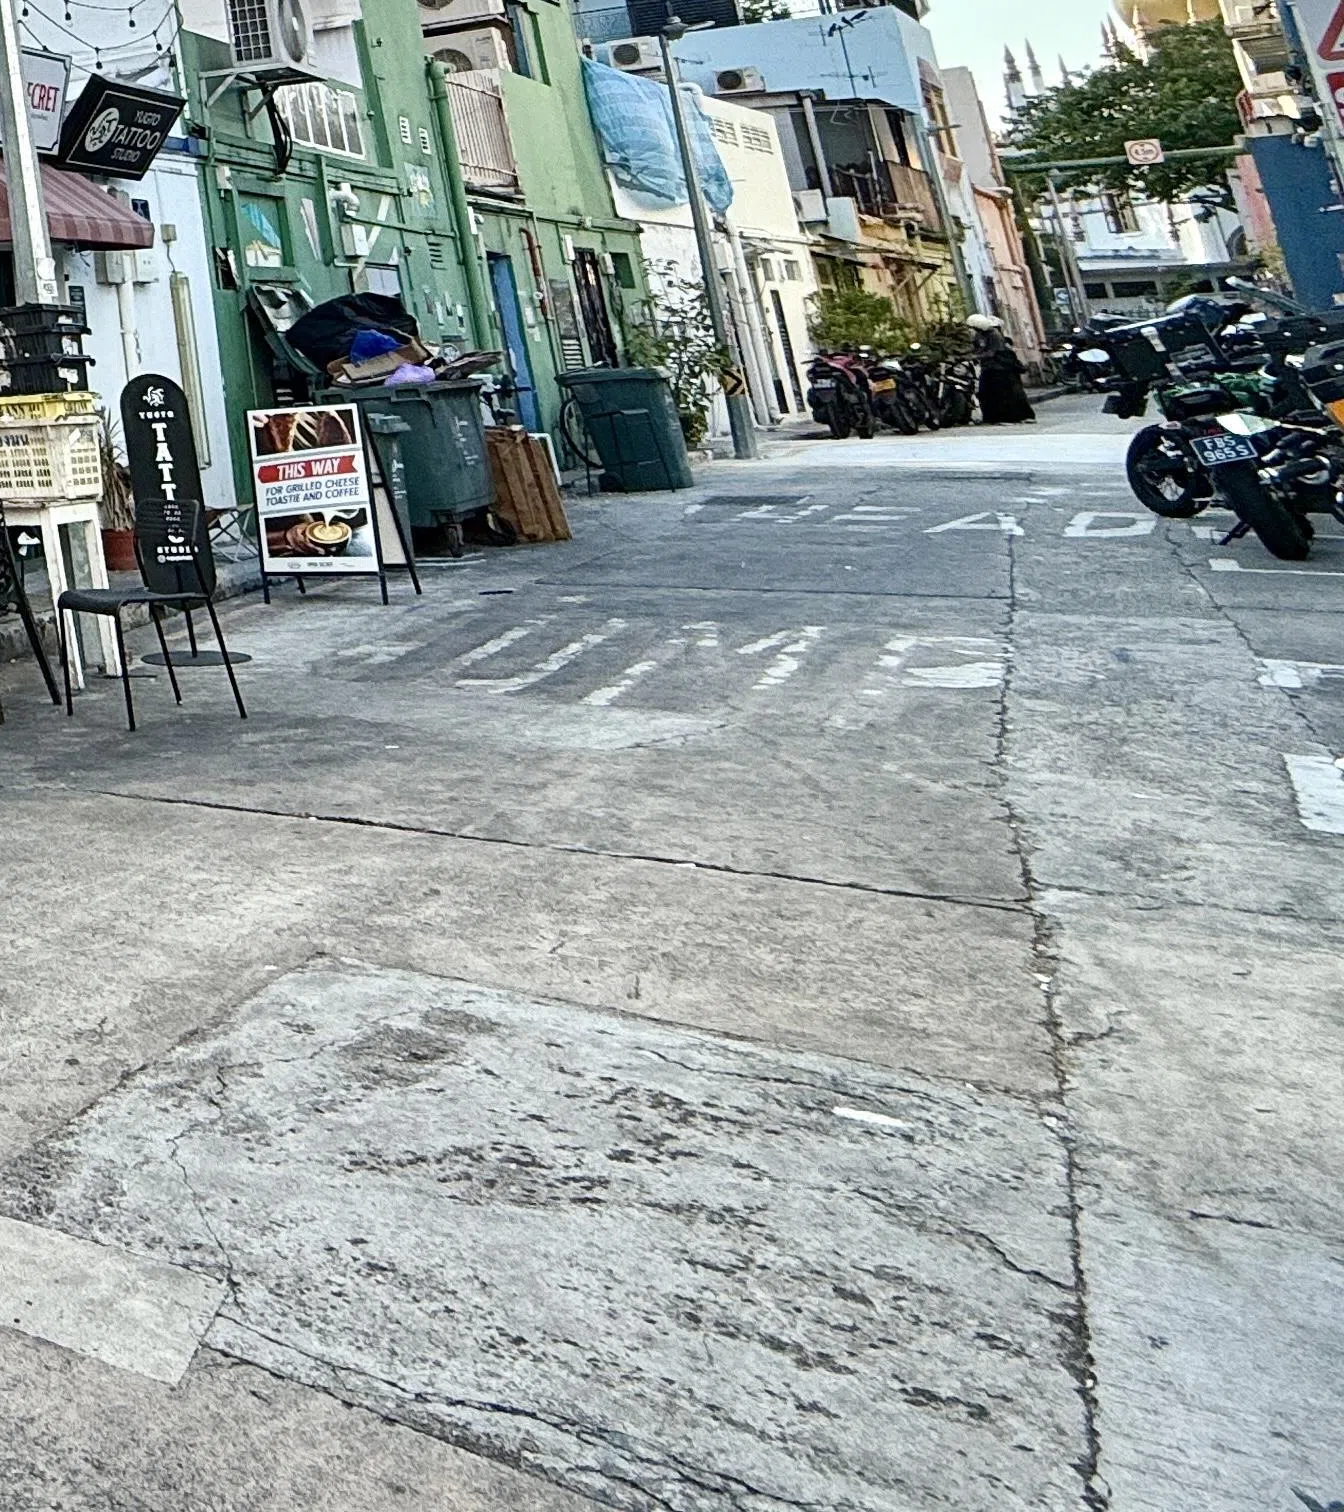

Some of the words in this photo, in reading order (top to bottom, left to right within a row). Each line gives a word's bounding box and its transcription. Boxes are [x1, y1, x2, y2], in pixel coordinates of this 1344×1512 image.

[111, 124, 161, 150] TATTOO
[1203, 435, 1237, 450] FBS
[277, 462, 306, 481] THIS
[312, 457, 341, 476] WAY
[265, 485, 284, 497] FOR
[286, 480, 322, 494] GRILLED
[325, 477, 360, 489] CHEESE
[265, 493, 301, 506] TOASTIE
[303, 491, 323, 502] AND
[325, 487, 360, 499] COFFEE
